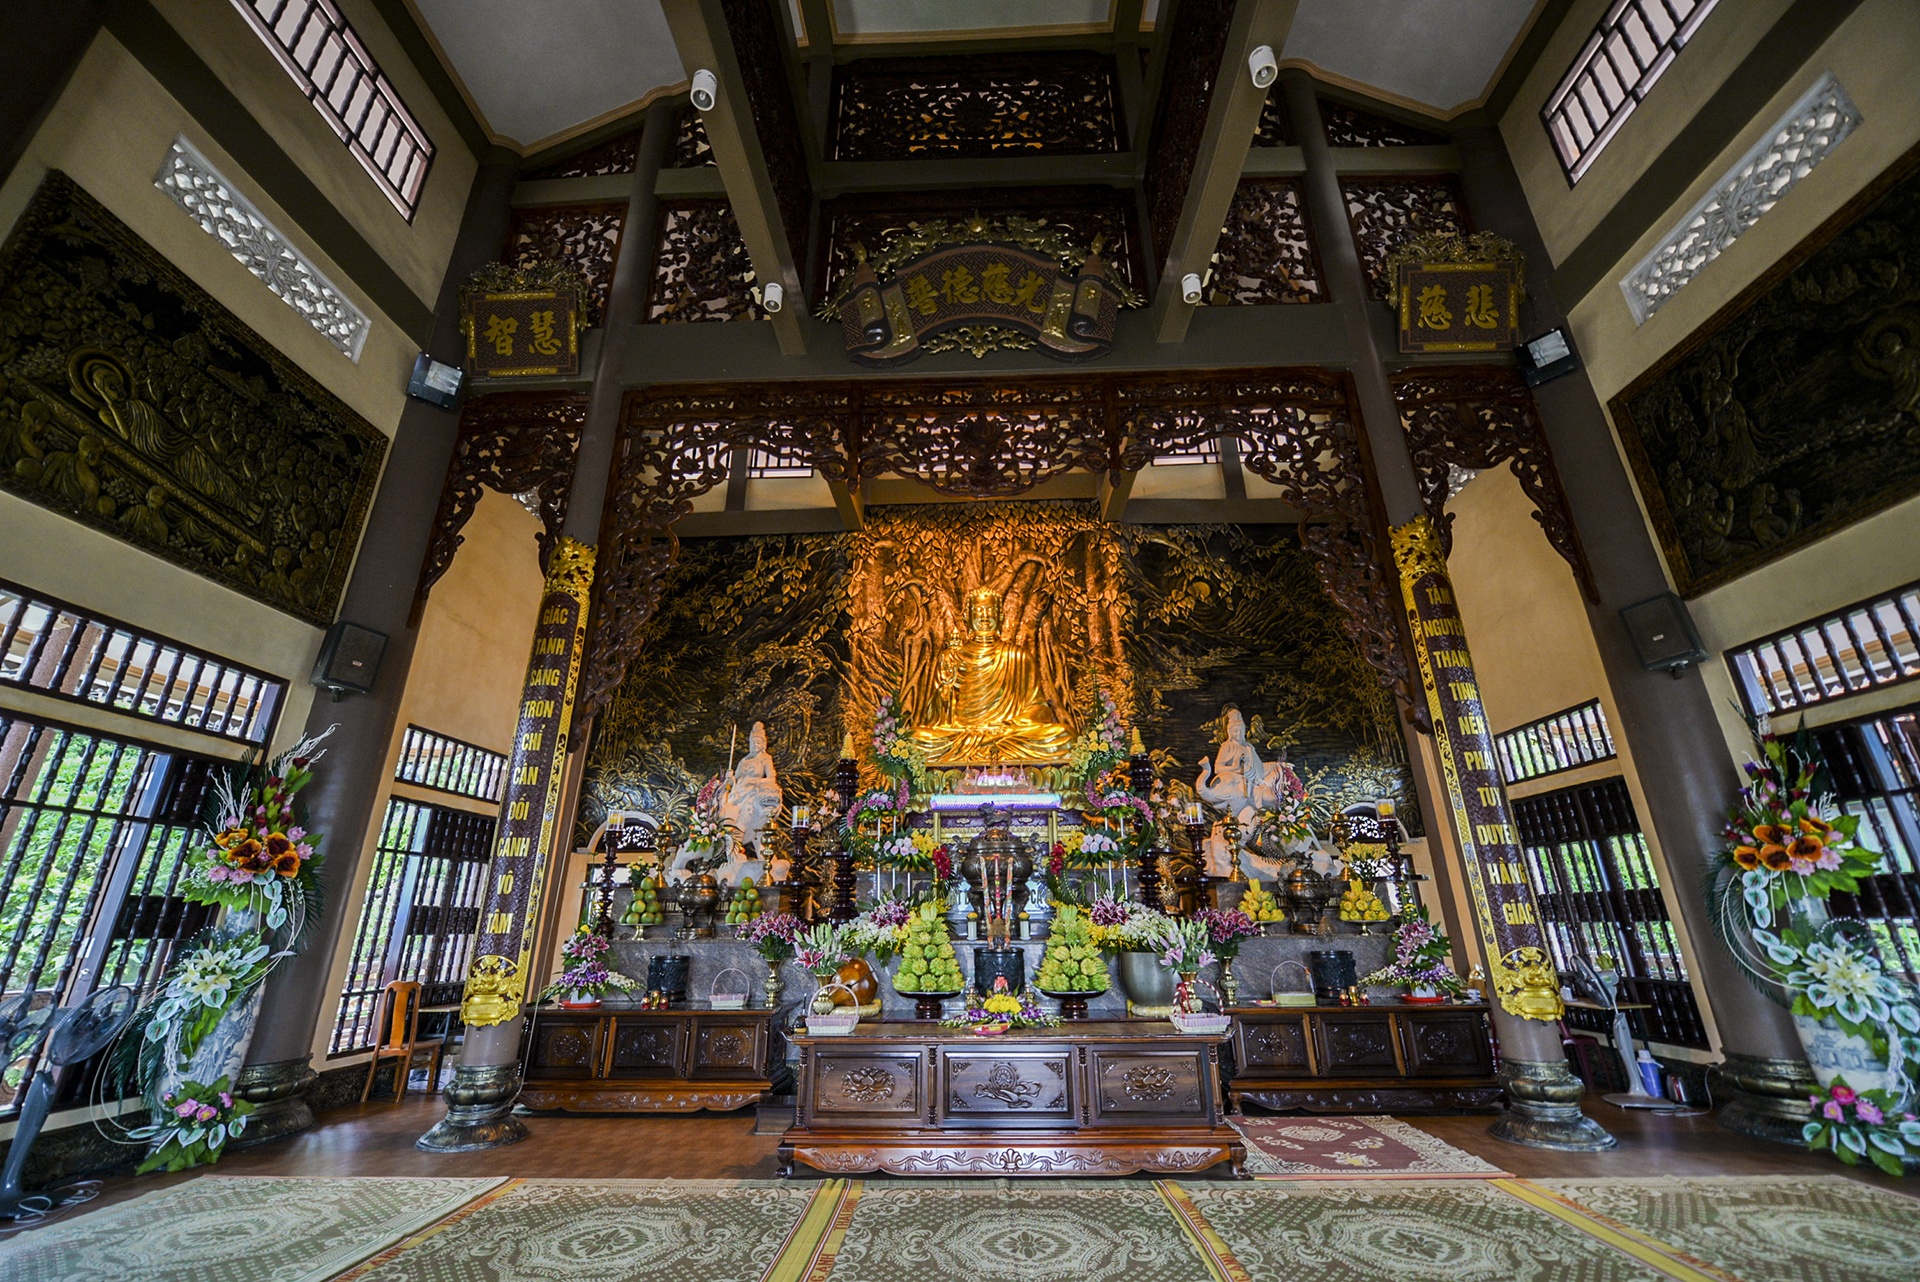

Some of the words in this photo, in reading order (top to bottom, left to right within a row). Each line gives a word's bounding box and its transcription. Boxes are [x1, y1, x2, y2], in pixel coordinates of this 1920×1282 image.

[1416, 284, 1500, 330] 慈悲
[482, 310, 562, 356] 智慧
[543, 604, 569, 625] GIÁC
[529, 664, 561, 687] SÁNG
[523, 696, 555, 719] TRÒN
[1425, 584, 1451, 605] TÂM
[1476, 783, 1502, 807] TÙY
[496, 870, 515, 895] VÔ
[485, 909, 514, 935] TÂM
